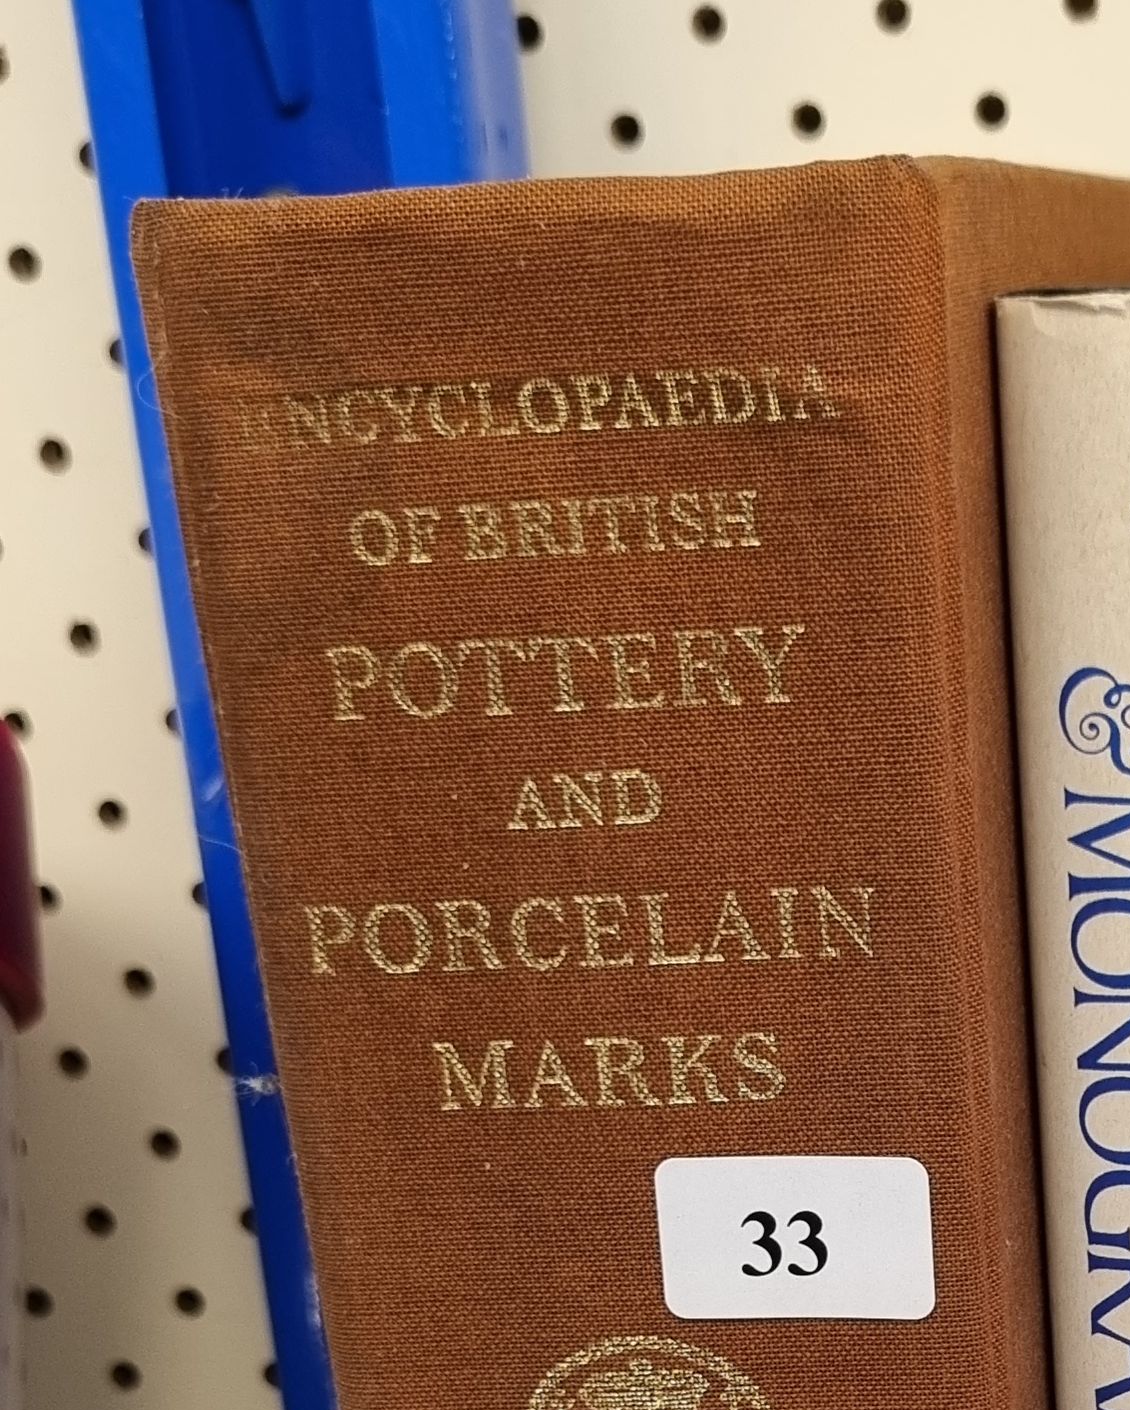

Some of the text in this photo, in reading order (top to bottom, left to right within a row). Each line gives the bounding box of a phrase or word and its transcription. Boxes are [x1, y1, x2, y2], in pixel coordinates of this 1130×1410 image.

[348, 489, 762, 567] OF BRITISH
[325, 624, 806, 721] POTTERY
[506, 768, 663, 831] AND
[304, 886, 876, 976] PORCELAIN
[432, 1032, 787, 1112] MARKS
[740, 1210, 829, 1277] 33
